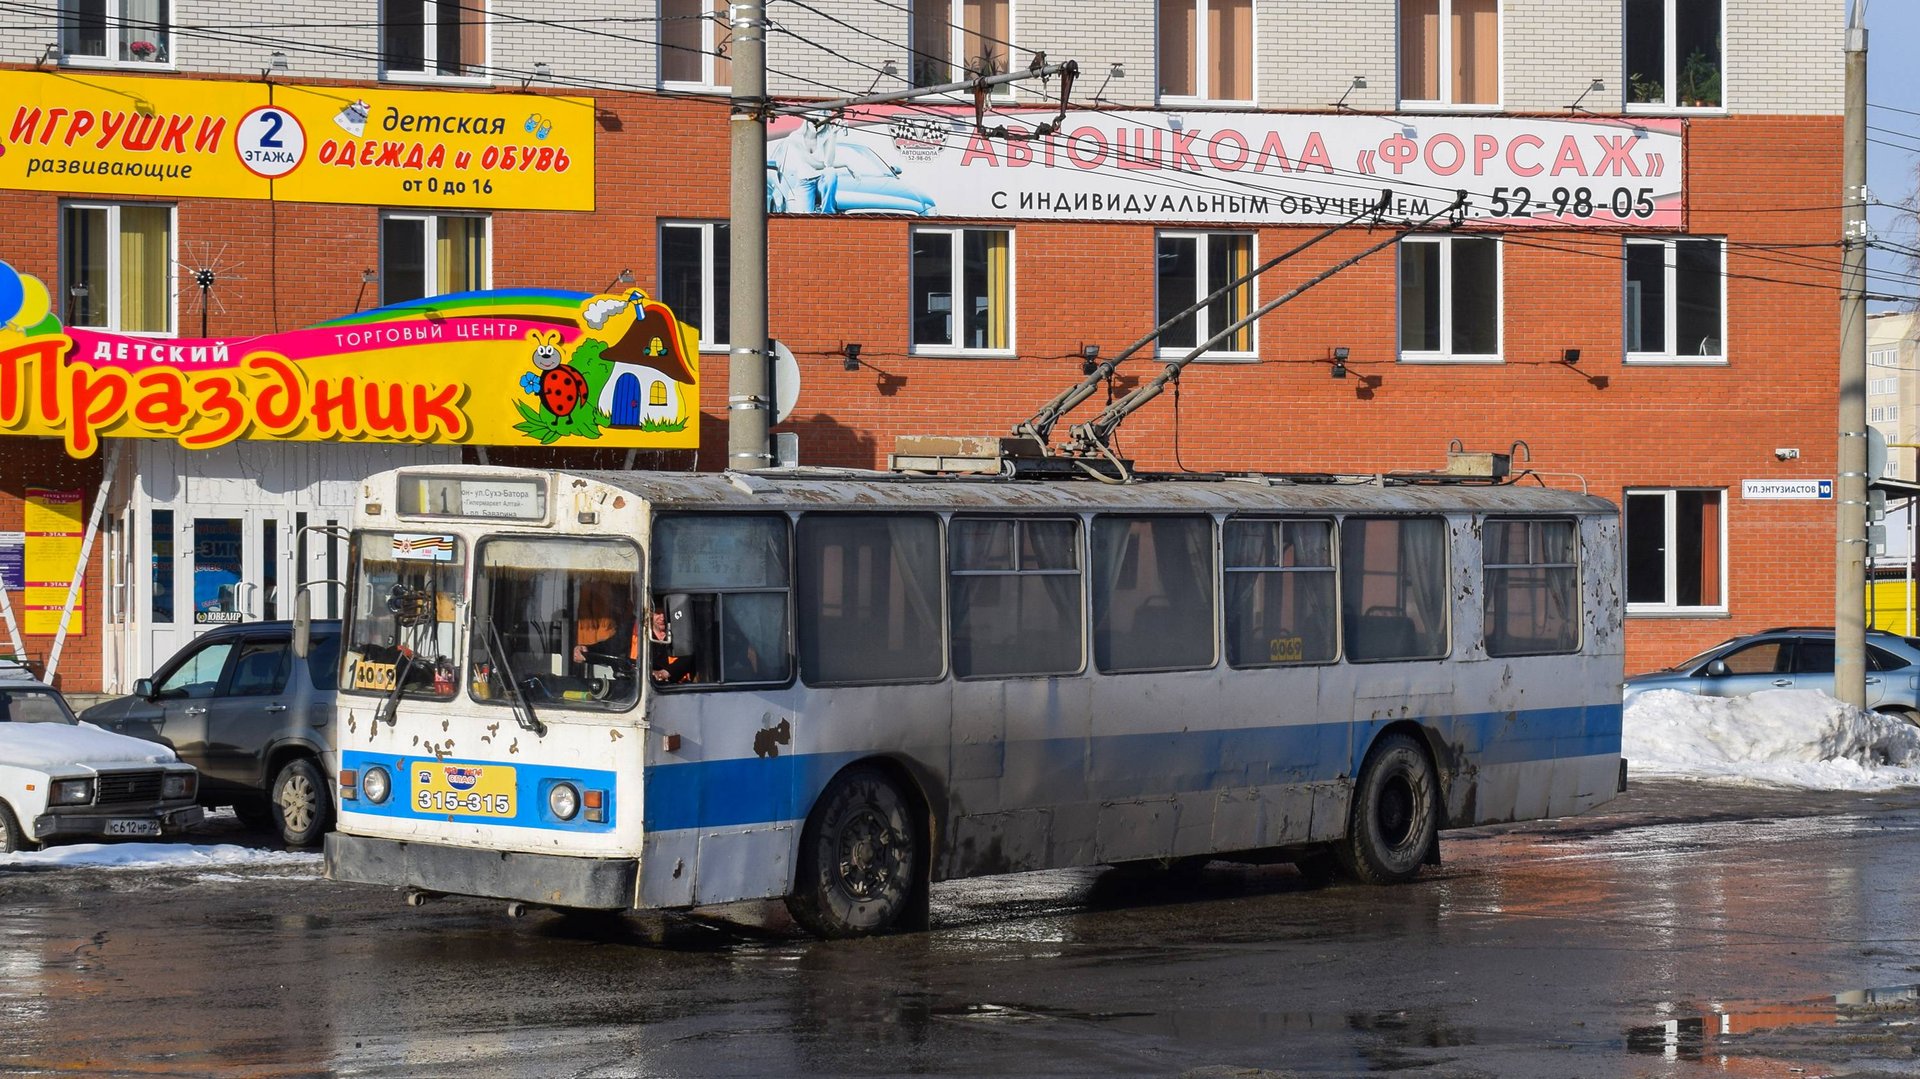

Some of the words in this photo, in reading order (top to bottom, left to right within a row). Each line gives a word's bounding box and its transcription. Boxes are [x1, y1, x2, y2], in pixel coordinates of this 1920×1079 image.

[9, 106, 227, 154] ИГРУШКИ
[259, 111, 284, 148] 2
[382, 107, 506, 134] детская
[245, 150, 295, 164] ЭТАЖА
[319, 140, 445, 170] ОДЕЖДА
[455, 151, 471, 170] и
[481, 145, 570, 173] ОБУВЬ
[960, 124, 1334, 174] АВТОШКОЛА
[1357, 132, 1664, 177] «ФОРСАЖ»
[26, 157, 193, 181] развивающие
[403, 180, 422, 192] от
[428, 177, 438, 192] 0
[443, 181, 466, 195] до
[472, 179, 493, 194] 16
[1019, 191, 1268, 214] ИНДИВИДУАЛЬНЫМ
[1489, 187, 1654, 218] 52-98-05
[336, 324, 442, 348] ТОРГОВЫЙ
[457, 324, 517, 338] ЦЕНТР
[94, 341, 229, 362] ДЕТСКИЙ
[0, 340, 464, 451] Праздник
[440, 487, 449, 513] 1
[1819, 484, 1830, 495] 10
[208, 612, 241, 620] ЮВЕЛИР
[418, 790, 509, 813] 315-315
